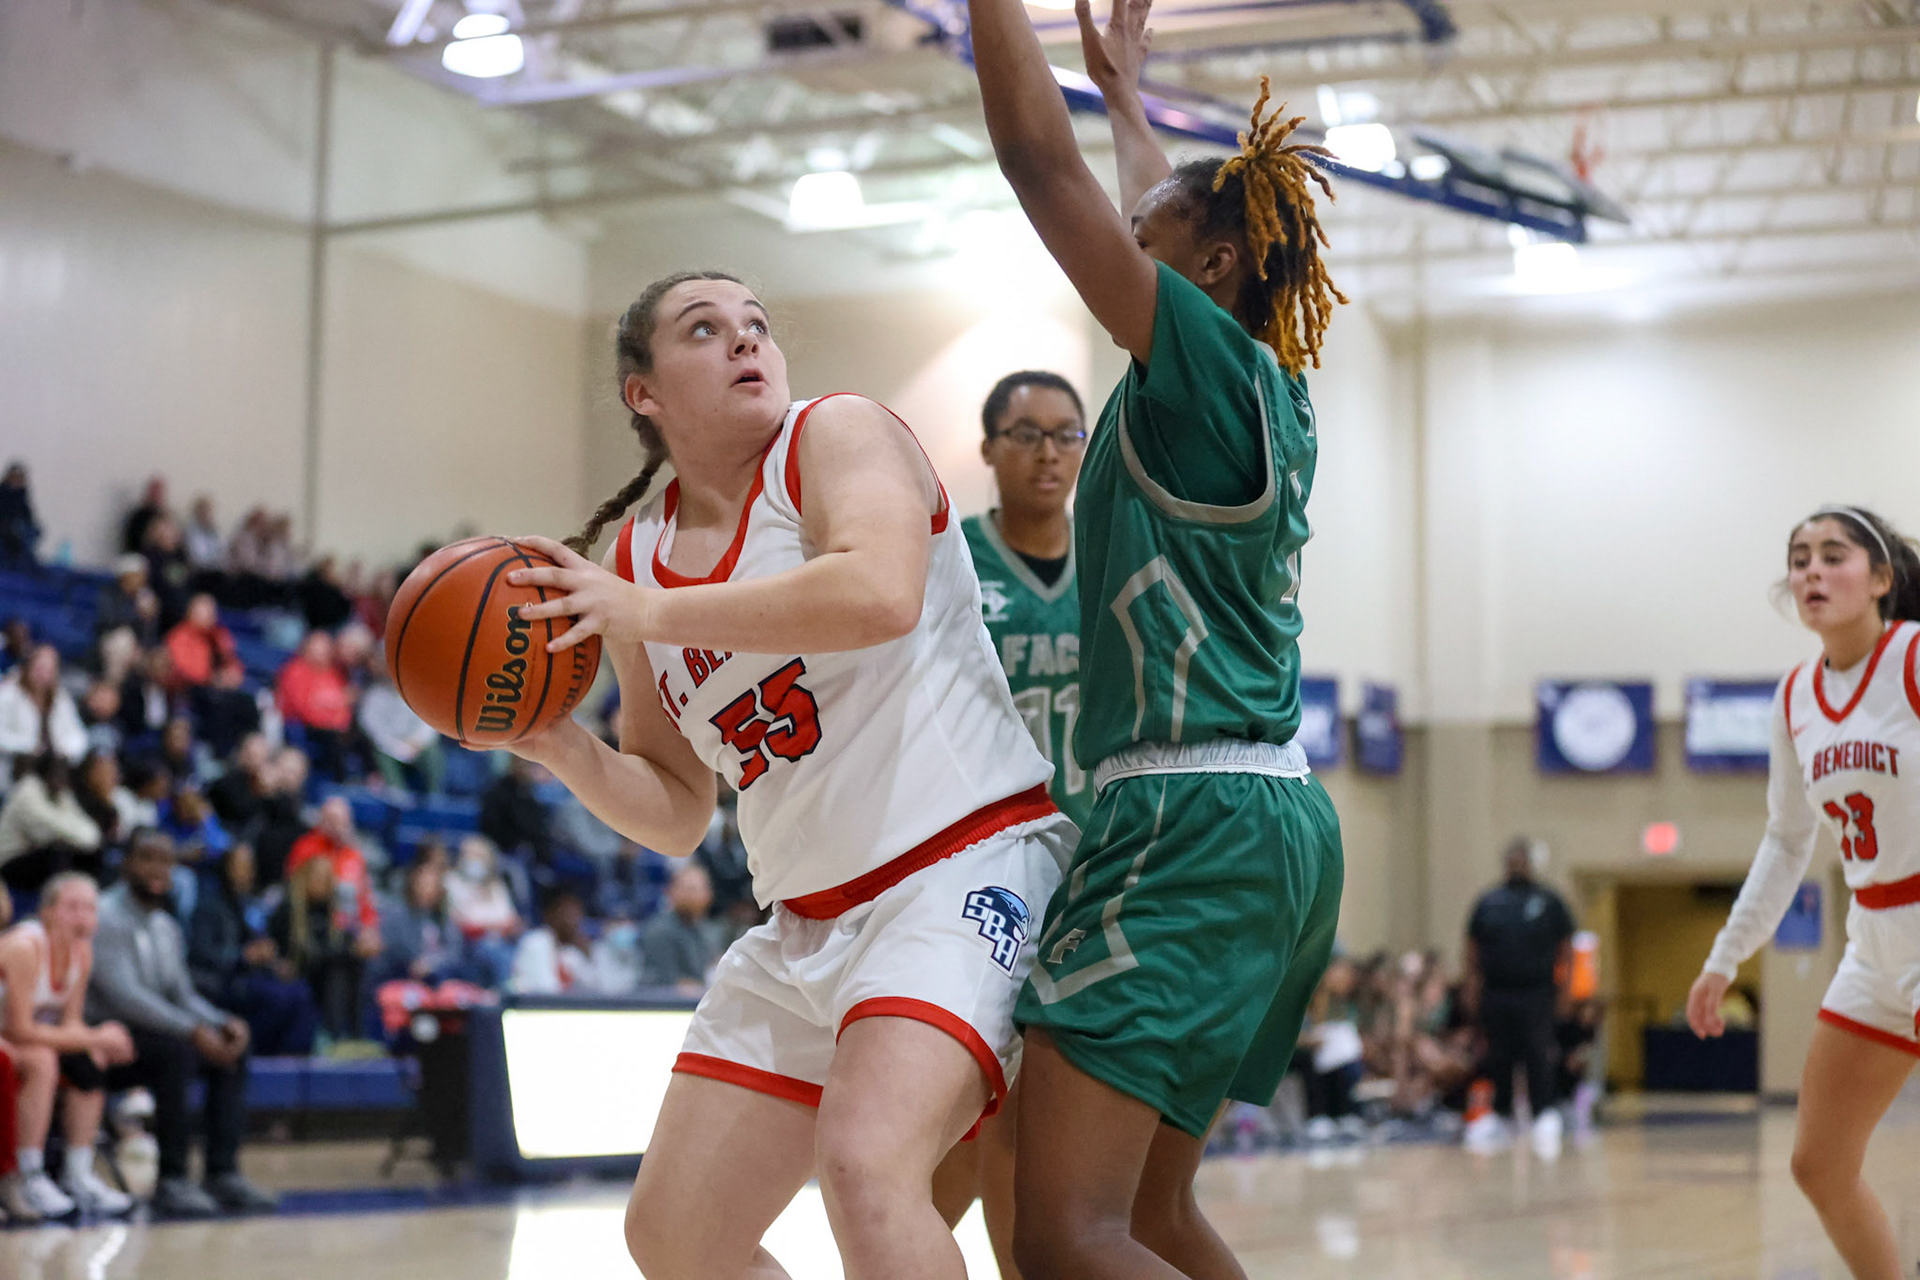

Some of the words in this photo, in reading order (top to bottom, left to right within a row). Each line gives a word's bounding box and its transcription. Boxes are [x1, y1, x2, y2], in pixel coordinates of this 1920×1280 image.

[474, 605, 533, 732] Wilson
[708, 656, 822, 792] 55
[1812, 740, 1899, 782] BENEDICT
[964, 892, 1019, 971] SBA
